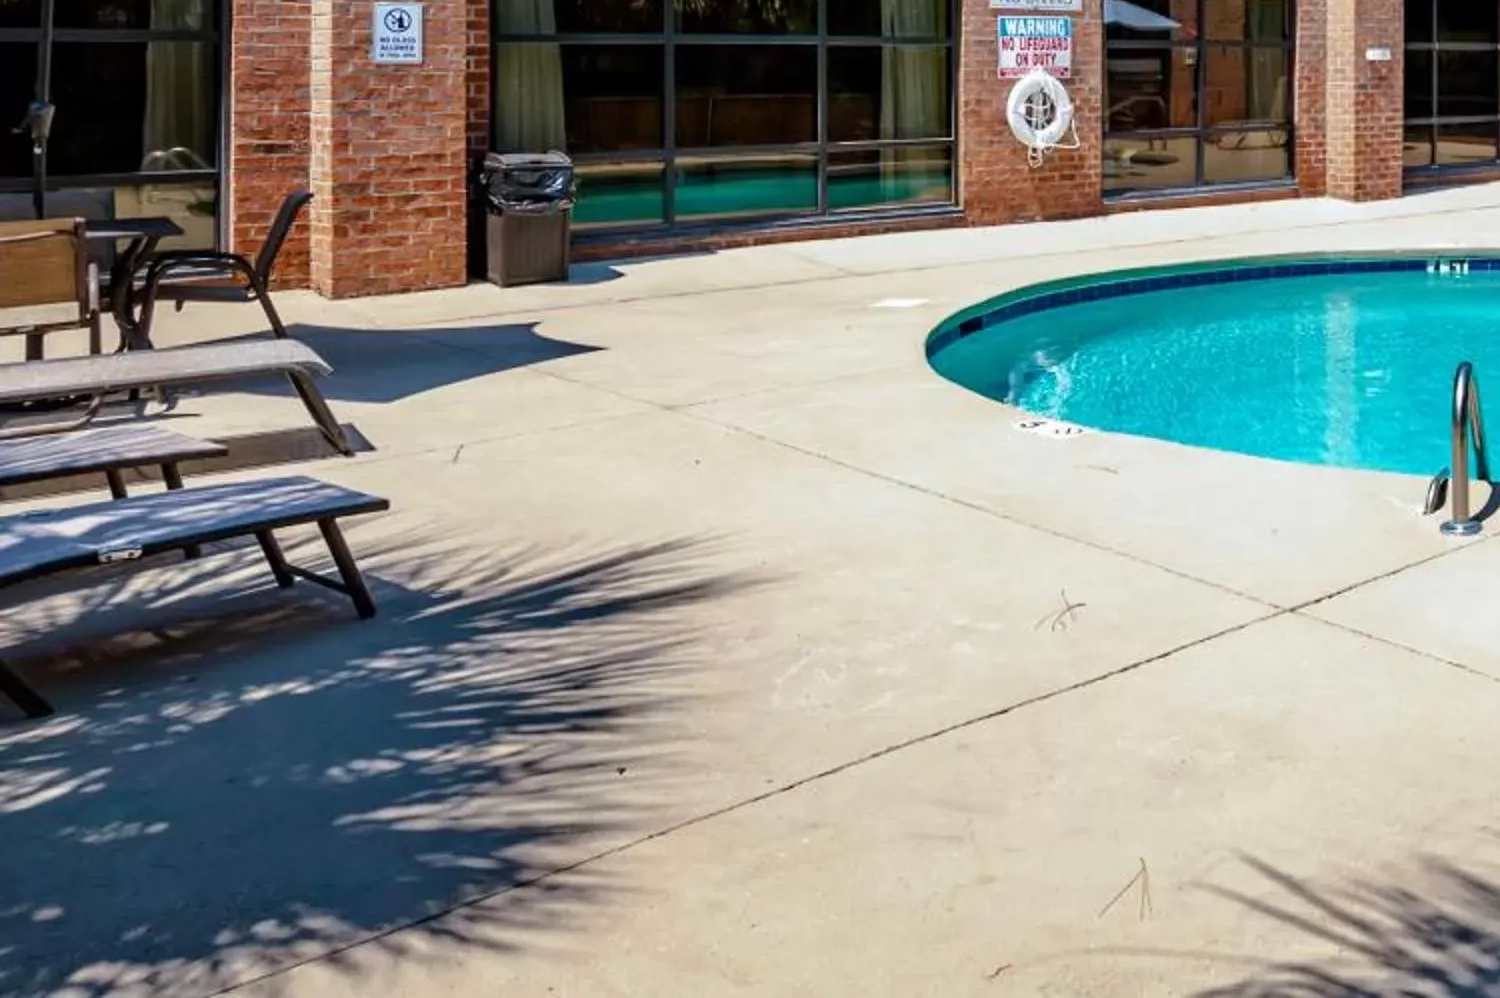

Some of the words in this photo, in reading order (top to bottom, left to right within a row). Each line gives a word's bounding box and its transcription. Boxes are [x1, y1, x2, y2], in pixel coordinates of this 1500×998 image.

[1005, 18, 1065, 36] WARNING
[1002, 38, 1014, 50] NO
[1020, 38, 1068, 50] LIFEGUARD
[1016, 53, 1028, 66] ON
[1033, 53, 1056, 66] DUTY
